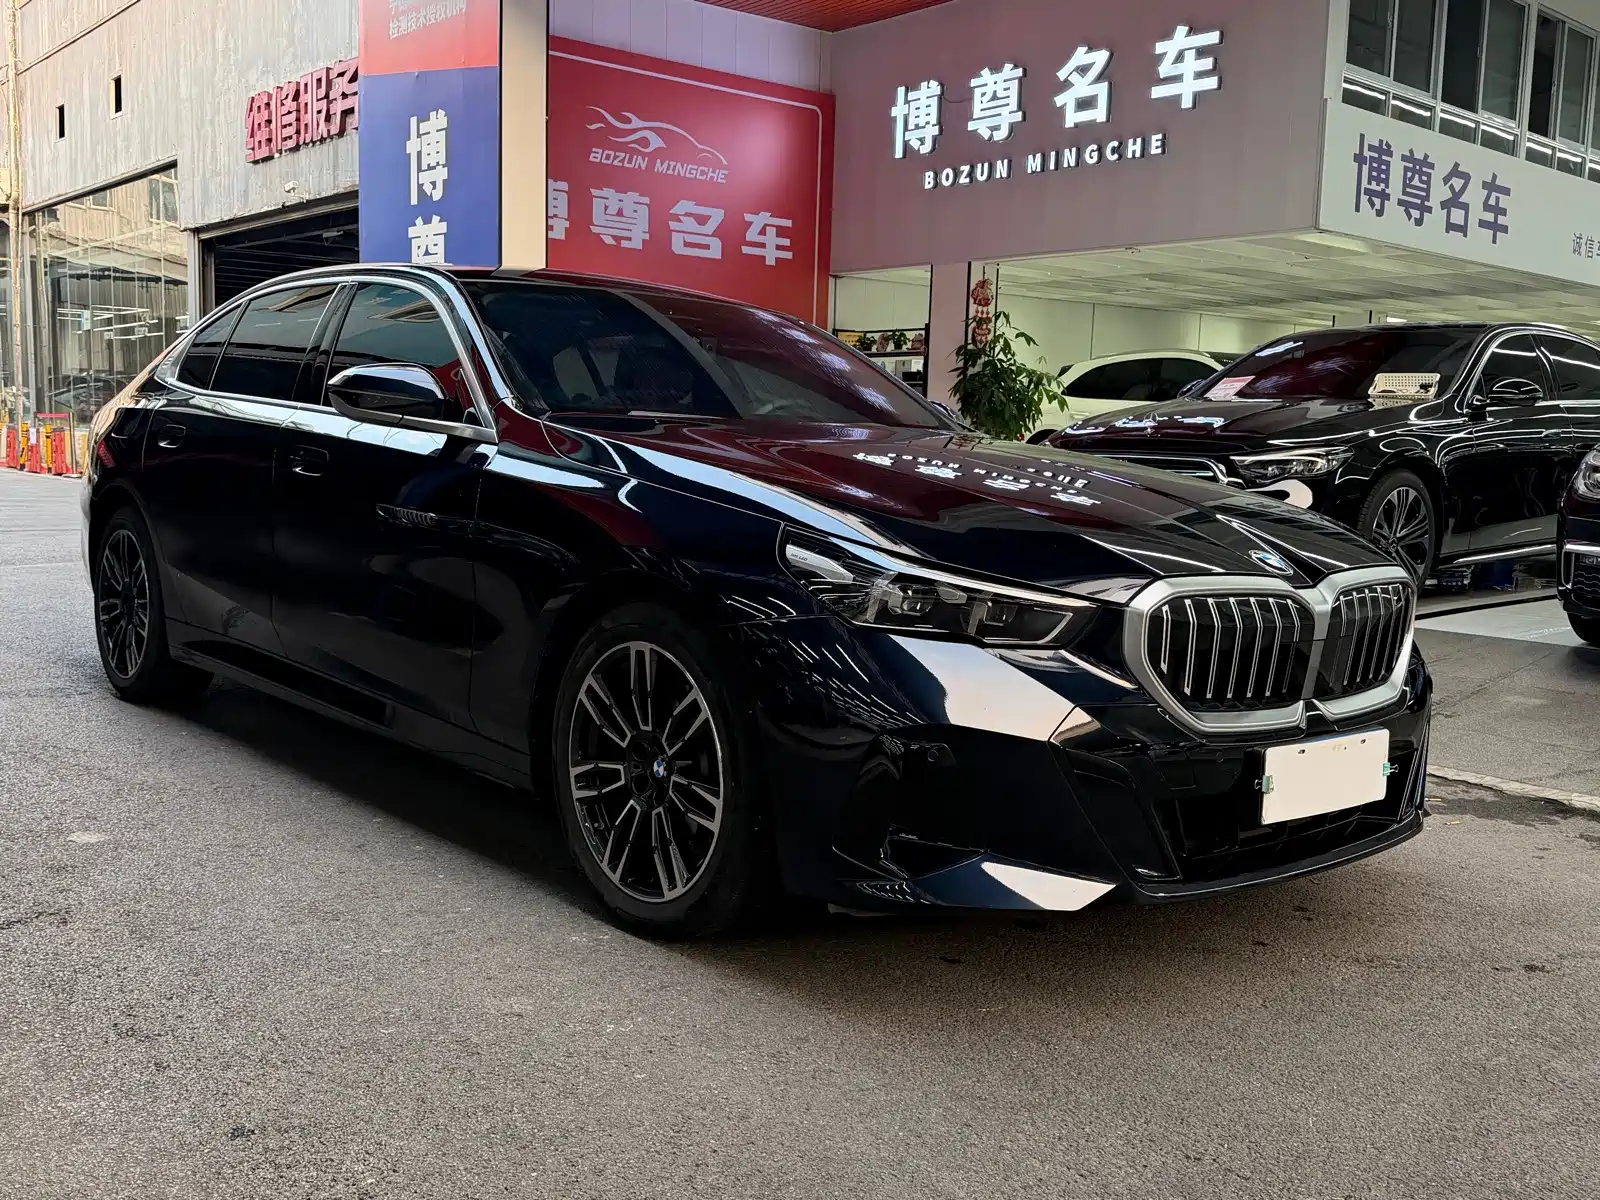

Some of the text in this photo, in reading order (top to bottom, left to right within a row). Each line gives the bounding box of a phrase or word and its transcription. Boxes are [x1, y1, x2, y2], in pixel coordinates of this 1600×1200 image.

[245, 57, 359, 163] 维修服务
[891, 25, 1224, 159] 博尊名车
[589, 147, 729, 184] BOZUN MINGCHE
[924, 133, 1168, 190] BOZUN MINGCHE
[1353, 133, 1511, 245] 博尊名车
